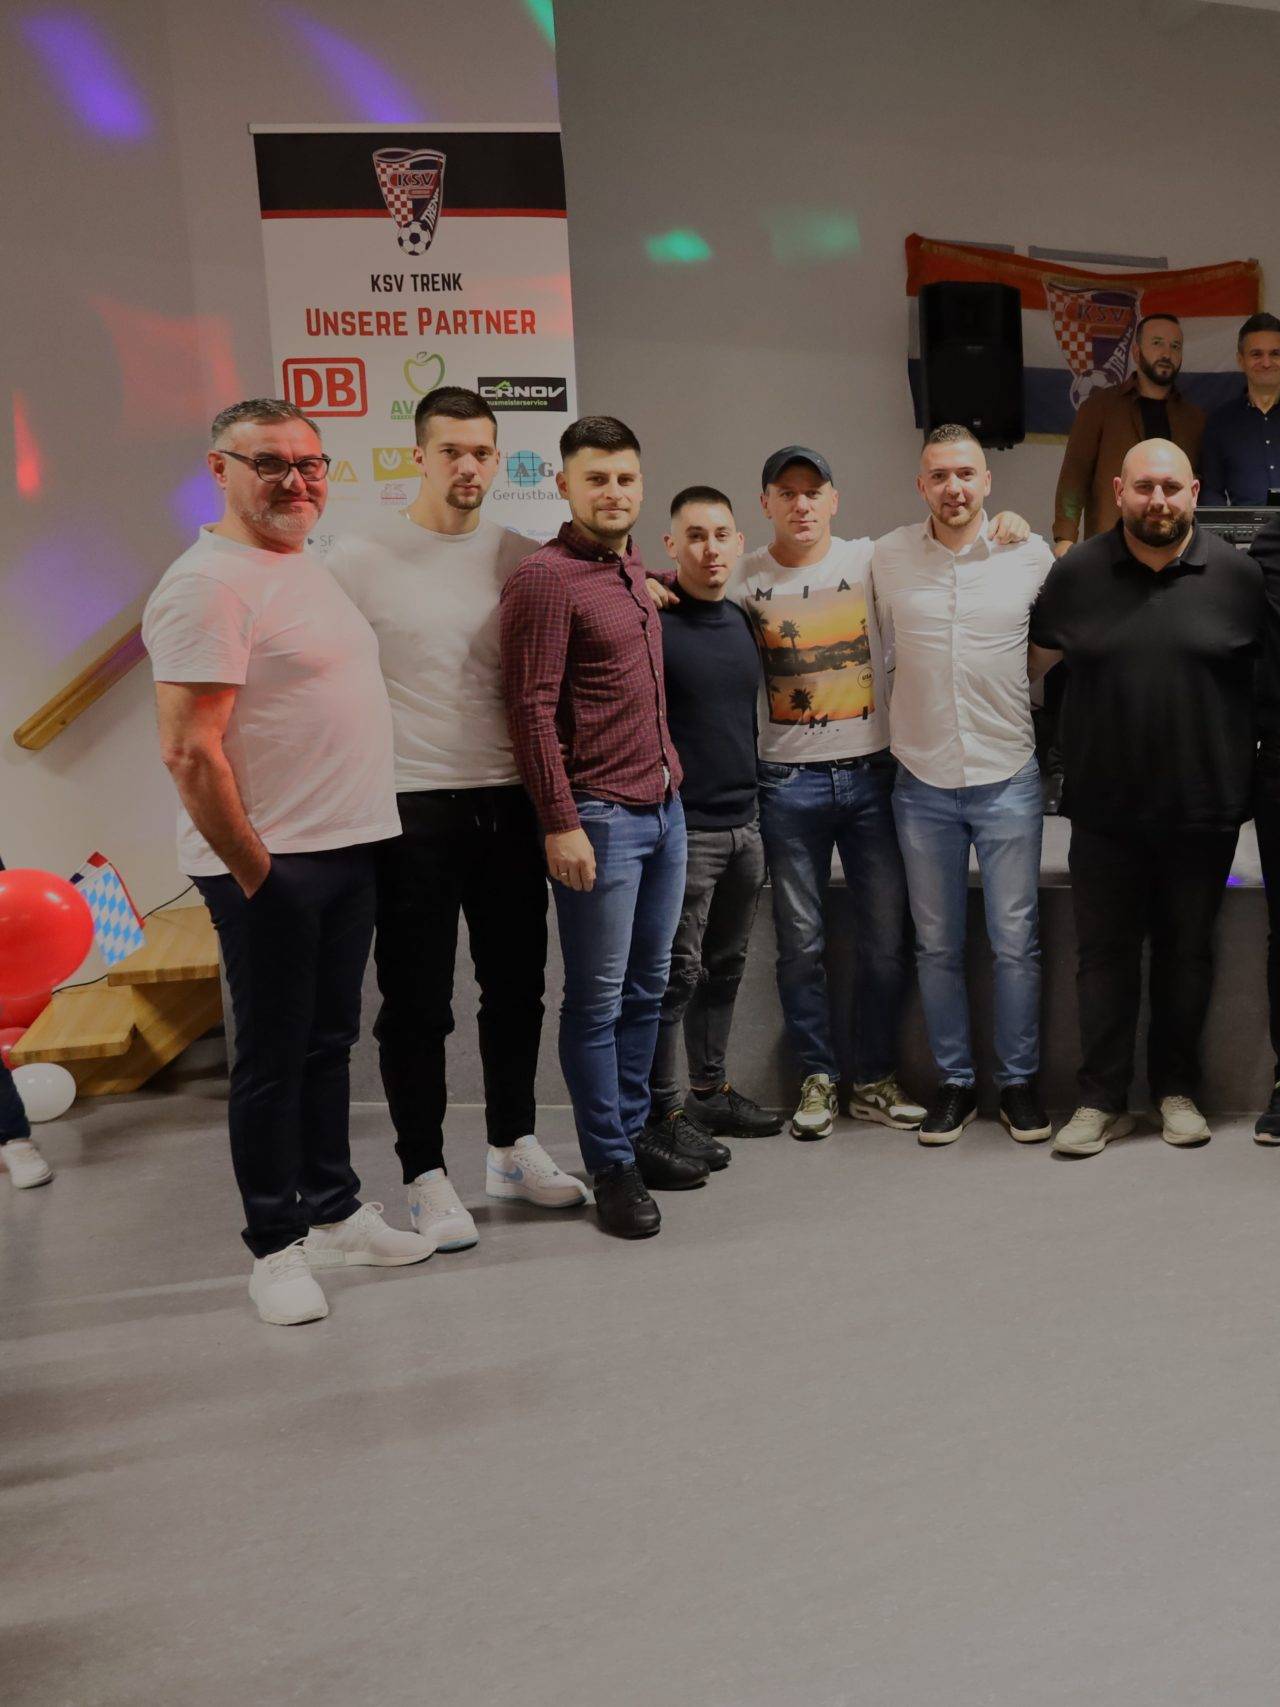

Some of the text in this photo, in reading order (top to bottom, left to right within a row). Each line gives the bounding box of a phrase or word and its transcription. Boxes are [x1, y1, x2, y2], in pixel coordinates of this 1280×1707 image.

[397, 173, 434, 187] KSV
[370, 273, 463, 293] KSV TRENK
[293, 367, 357, 408] DB
